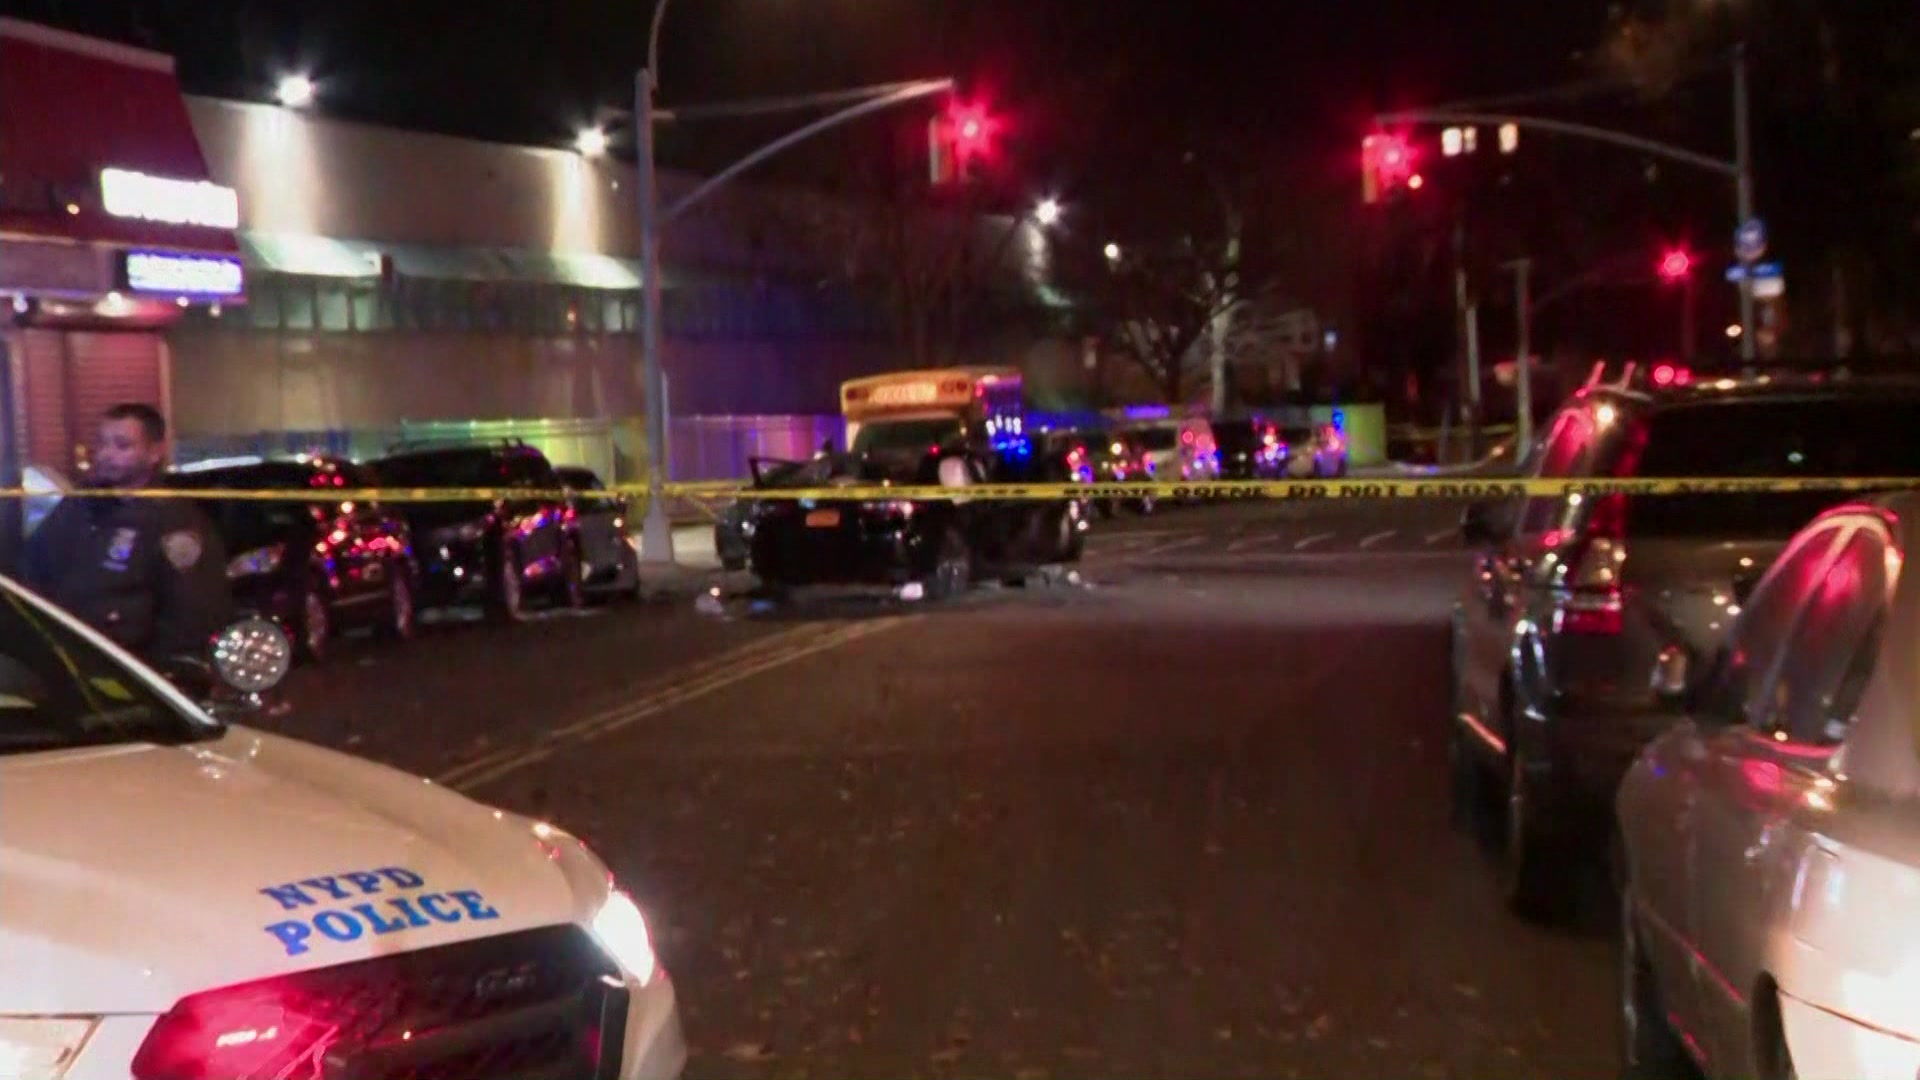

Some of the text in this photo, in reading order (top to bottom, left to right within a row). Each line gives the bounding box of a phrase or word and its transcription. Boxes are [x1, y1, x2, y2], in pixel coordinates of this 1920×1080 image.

[1340, 484, 1398, 498] NOT
[259, 867, 425, 910] NYPD
[264, 890, 500, 957] POLICE
